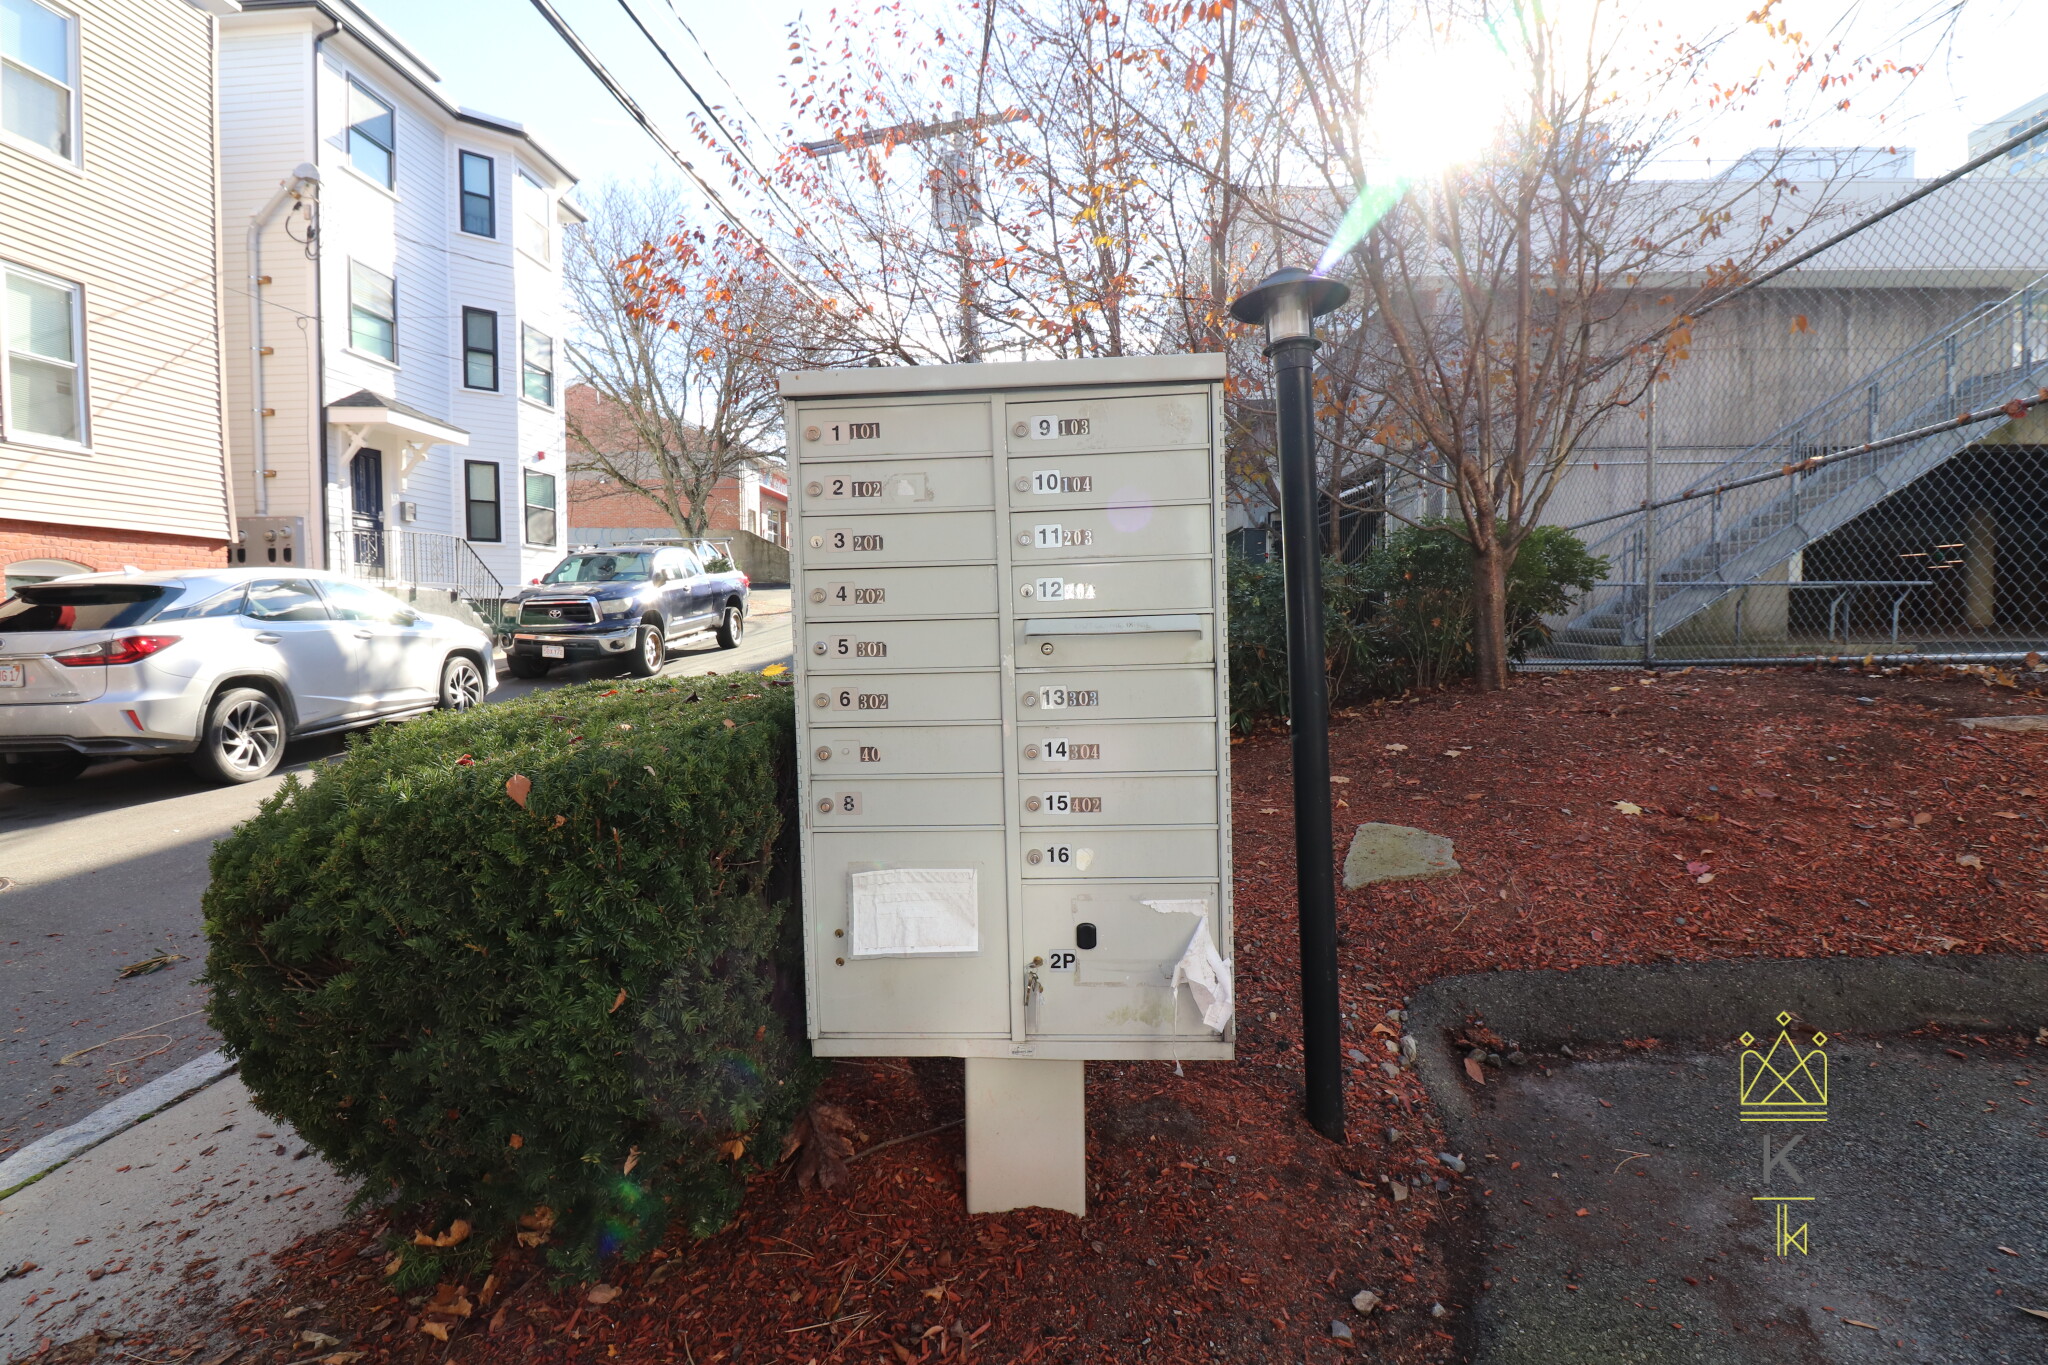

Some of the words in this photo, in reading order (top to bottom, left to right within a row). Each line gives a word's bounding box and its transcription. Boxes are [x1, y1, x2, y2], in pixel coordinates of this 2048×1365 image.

[832, 425, 839, 441] 1
[851, 423, 879, 439] 101
[1039, 419, 1051, 436] 9
[1060, 419, 1089, 436] 103
[832, 479, 844, 495] 2
[854, 482, 881, 497] 102
[1035, 474, 1058, 490] 10
[1062, 476, 1091, 492] 104
[834, 532, 845, 548] 3
[854, 535, 882, 551] 201
[1038, 528, 1059, 544] 11
[1063, 530, 1093, 546] 203
[836, 586, 847, 601] 4
[856, 589, 884, 604] 202
[1039, 581, 1062, 597] 12
[838, 638, 849, 654] 5
[858, 642, 885, 657] 301
[840, 691, 851, 707] 6
[860, 694, 888, 709] 302
[1042, 689, 1065, 705] 13
[1069, 691, 1098, 706] 303
[861, 747, 880, 762] 40
[1044, 741, 1067, 757] 14
[1071, 744, 1099, 760] 304
[843, 795, 854, 811] 8
[1045, 795, 1068, 811] 15
[1072, 798, 1101, 812] 402
[1047, 847, 1069, 863] 16
[1050, 953, 1076, 969] 2P
